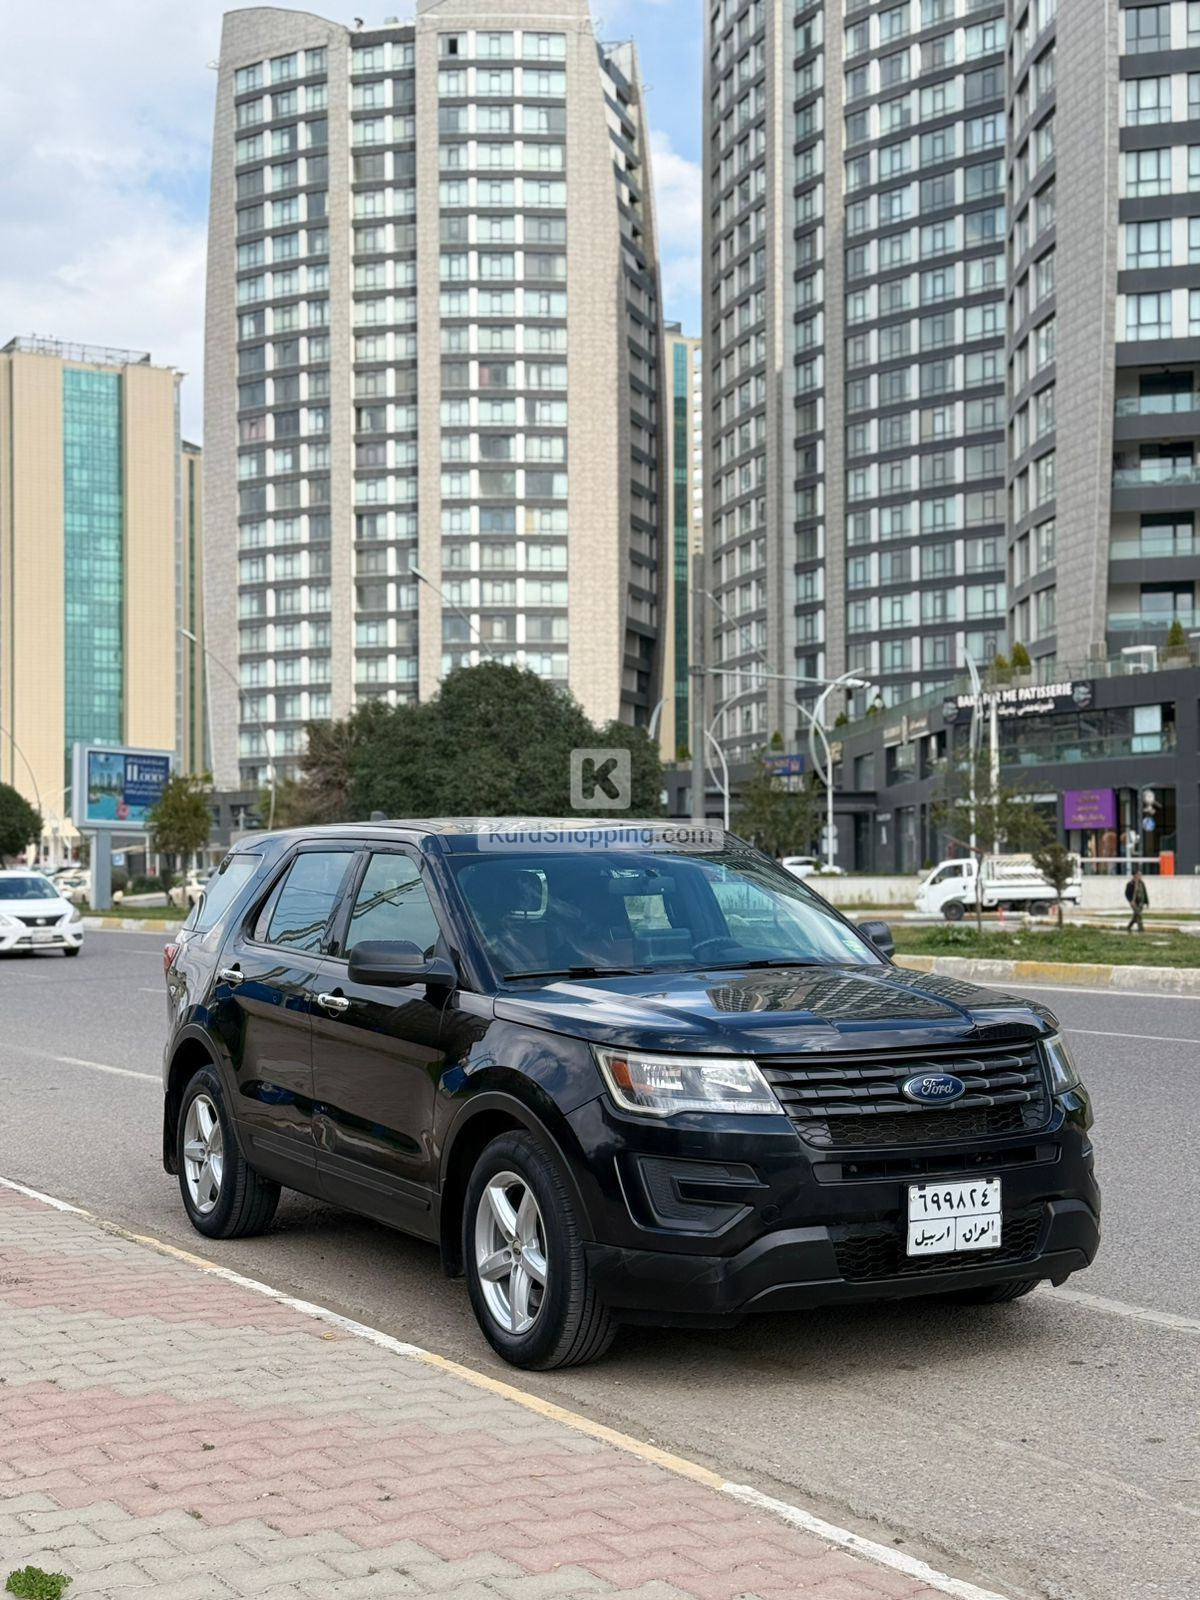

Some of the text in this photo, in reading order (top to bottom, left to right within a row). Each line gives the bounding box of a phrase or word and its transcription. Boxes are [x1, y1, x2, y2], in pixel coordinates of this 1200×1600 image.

[1002, 689, 1017, 702] ME
[1018, 682, 1072, 700] PATISSERIE
[921, 1078, 954, 1096] Ford
[918, 1188, 991, 1213] ٦٩٩٨٢٤
[914, 1220, 995, 1247] العراق اربيل
